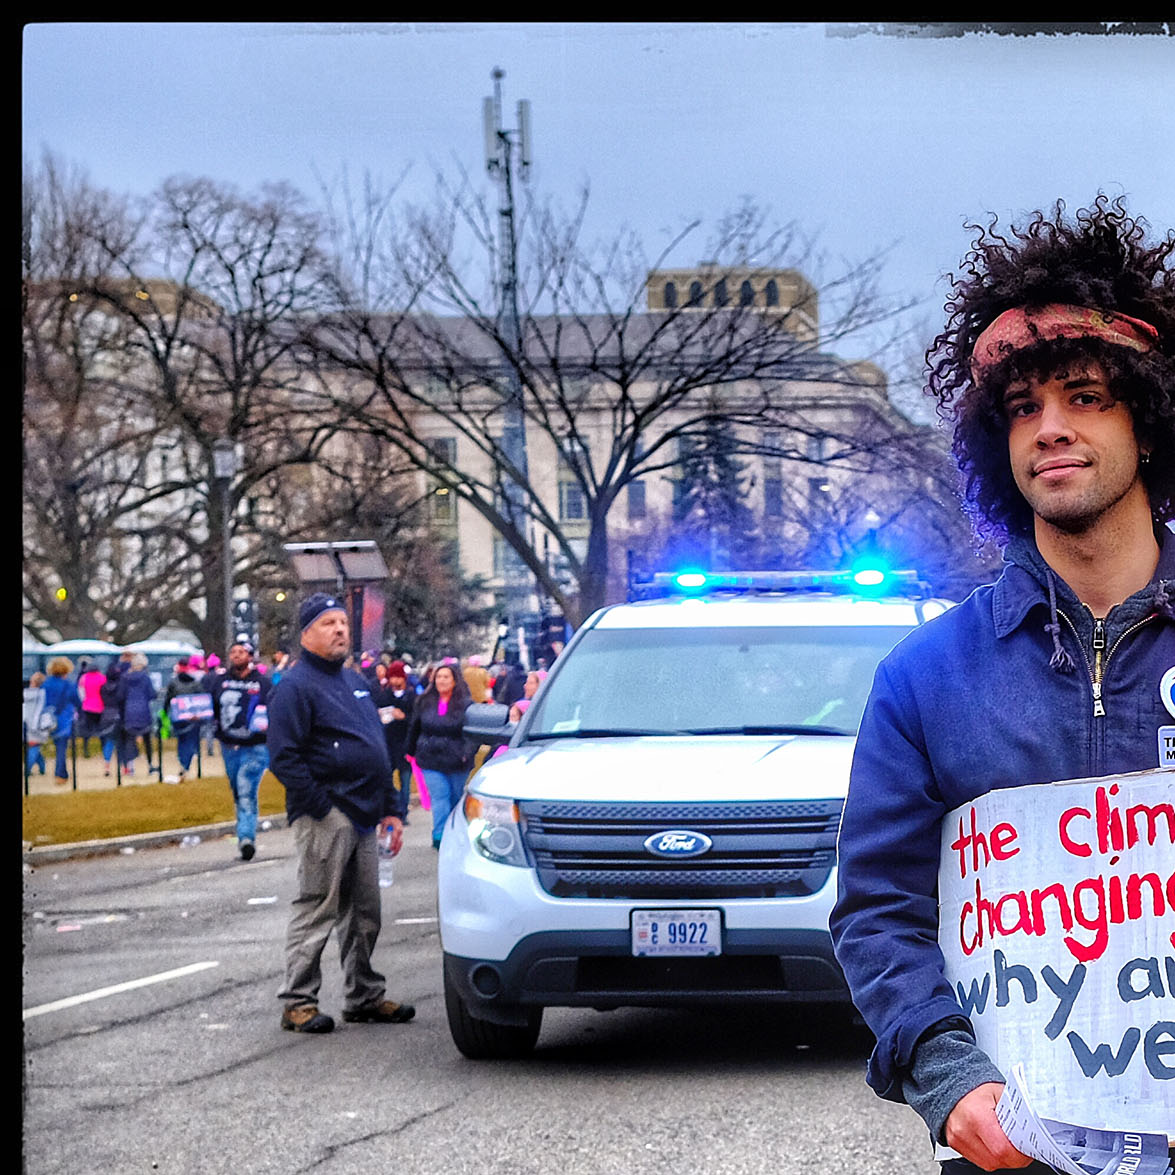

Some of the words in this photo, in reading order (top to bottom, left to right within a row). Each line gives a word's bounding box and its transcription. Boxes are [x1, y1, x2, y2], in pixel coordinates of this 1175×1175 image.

[658, 834, 696, 851] Ford
[951, 806, 1020, 879] the
[668, 922, 708, 944] 9922
[957, 949, 1087, 1041] why
